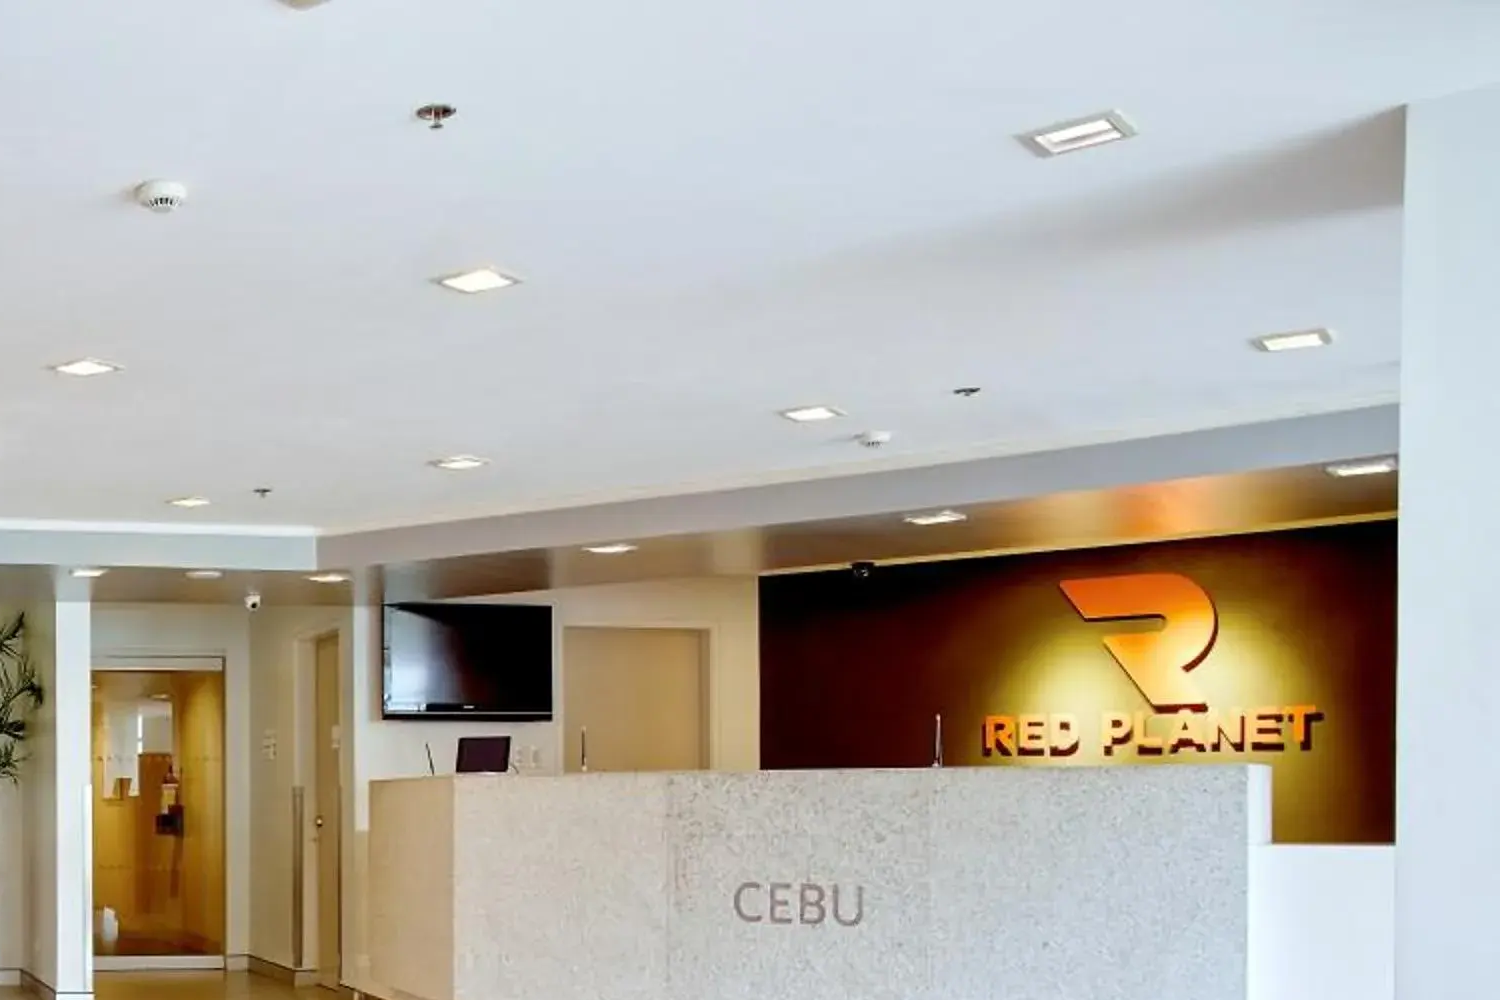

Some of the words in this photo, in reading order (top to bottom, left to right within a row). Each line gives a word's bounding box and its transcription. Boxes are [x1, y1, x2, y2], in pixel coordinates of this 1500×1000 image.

[982, 711, 1080, 757] RED
[1101, 705, 1323, 756] PLANET
[733, 881, 864, 927] CEBU
